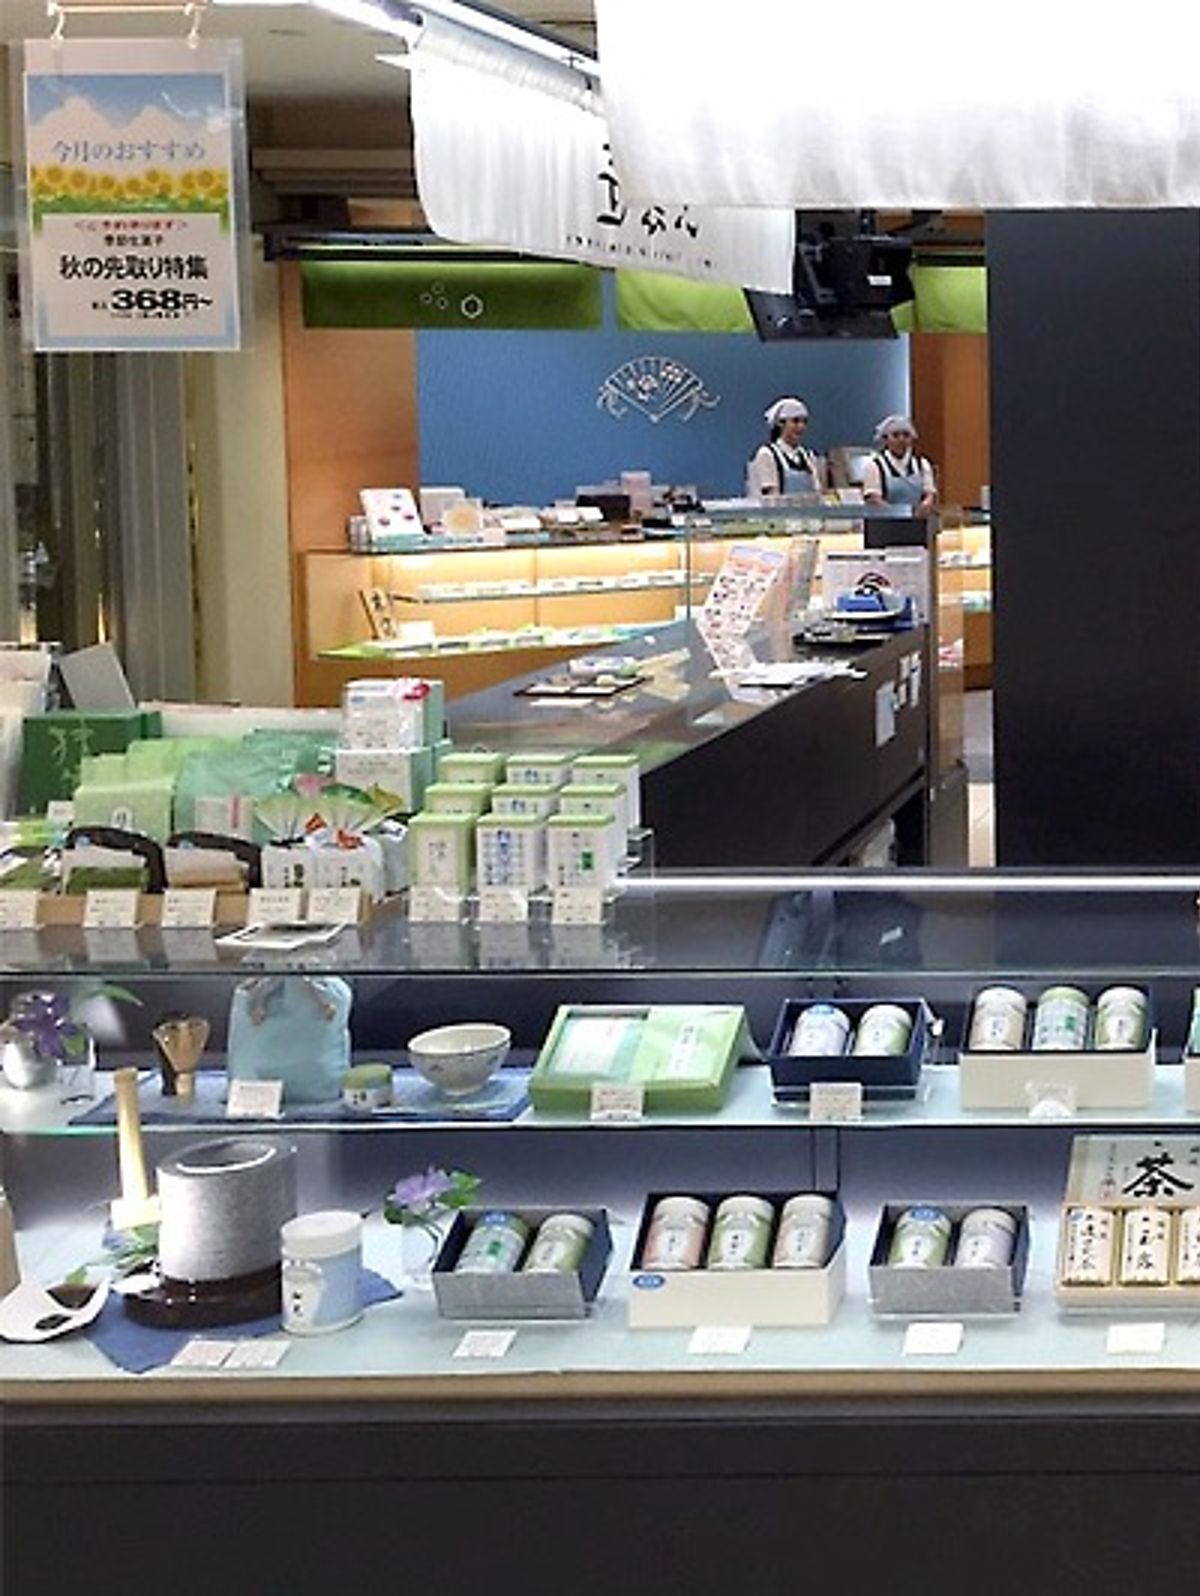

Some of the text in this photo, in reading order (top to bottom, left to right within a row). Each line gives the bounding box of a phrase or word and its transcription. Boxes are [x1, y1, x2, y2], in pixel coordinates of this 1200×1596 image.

[54, 140, 206, 162] 今月のおすすめ
[60, 254, 208, 280] 秋の先取り特集
